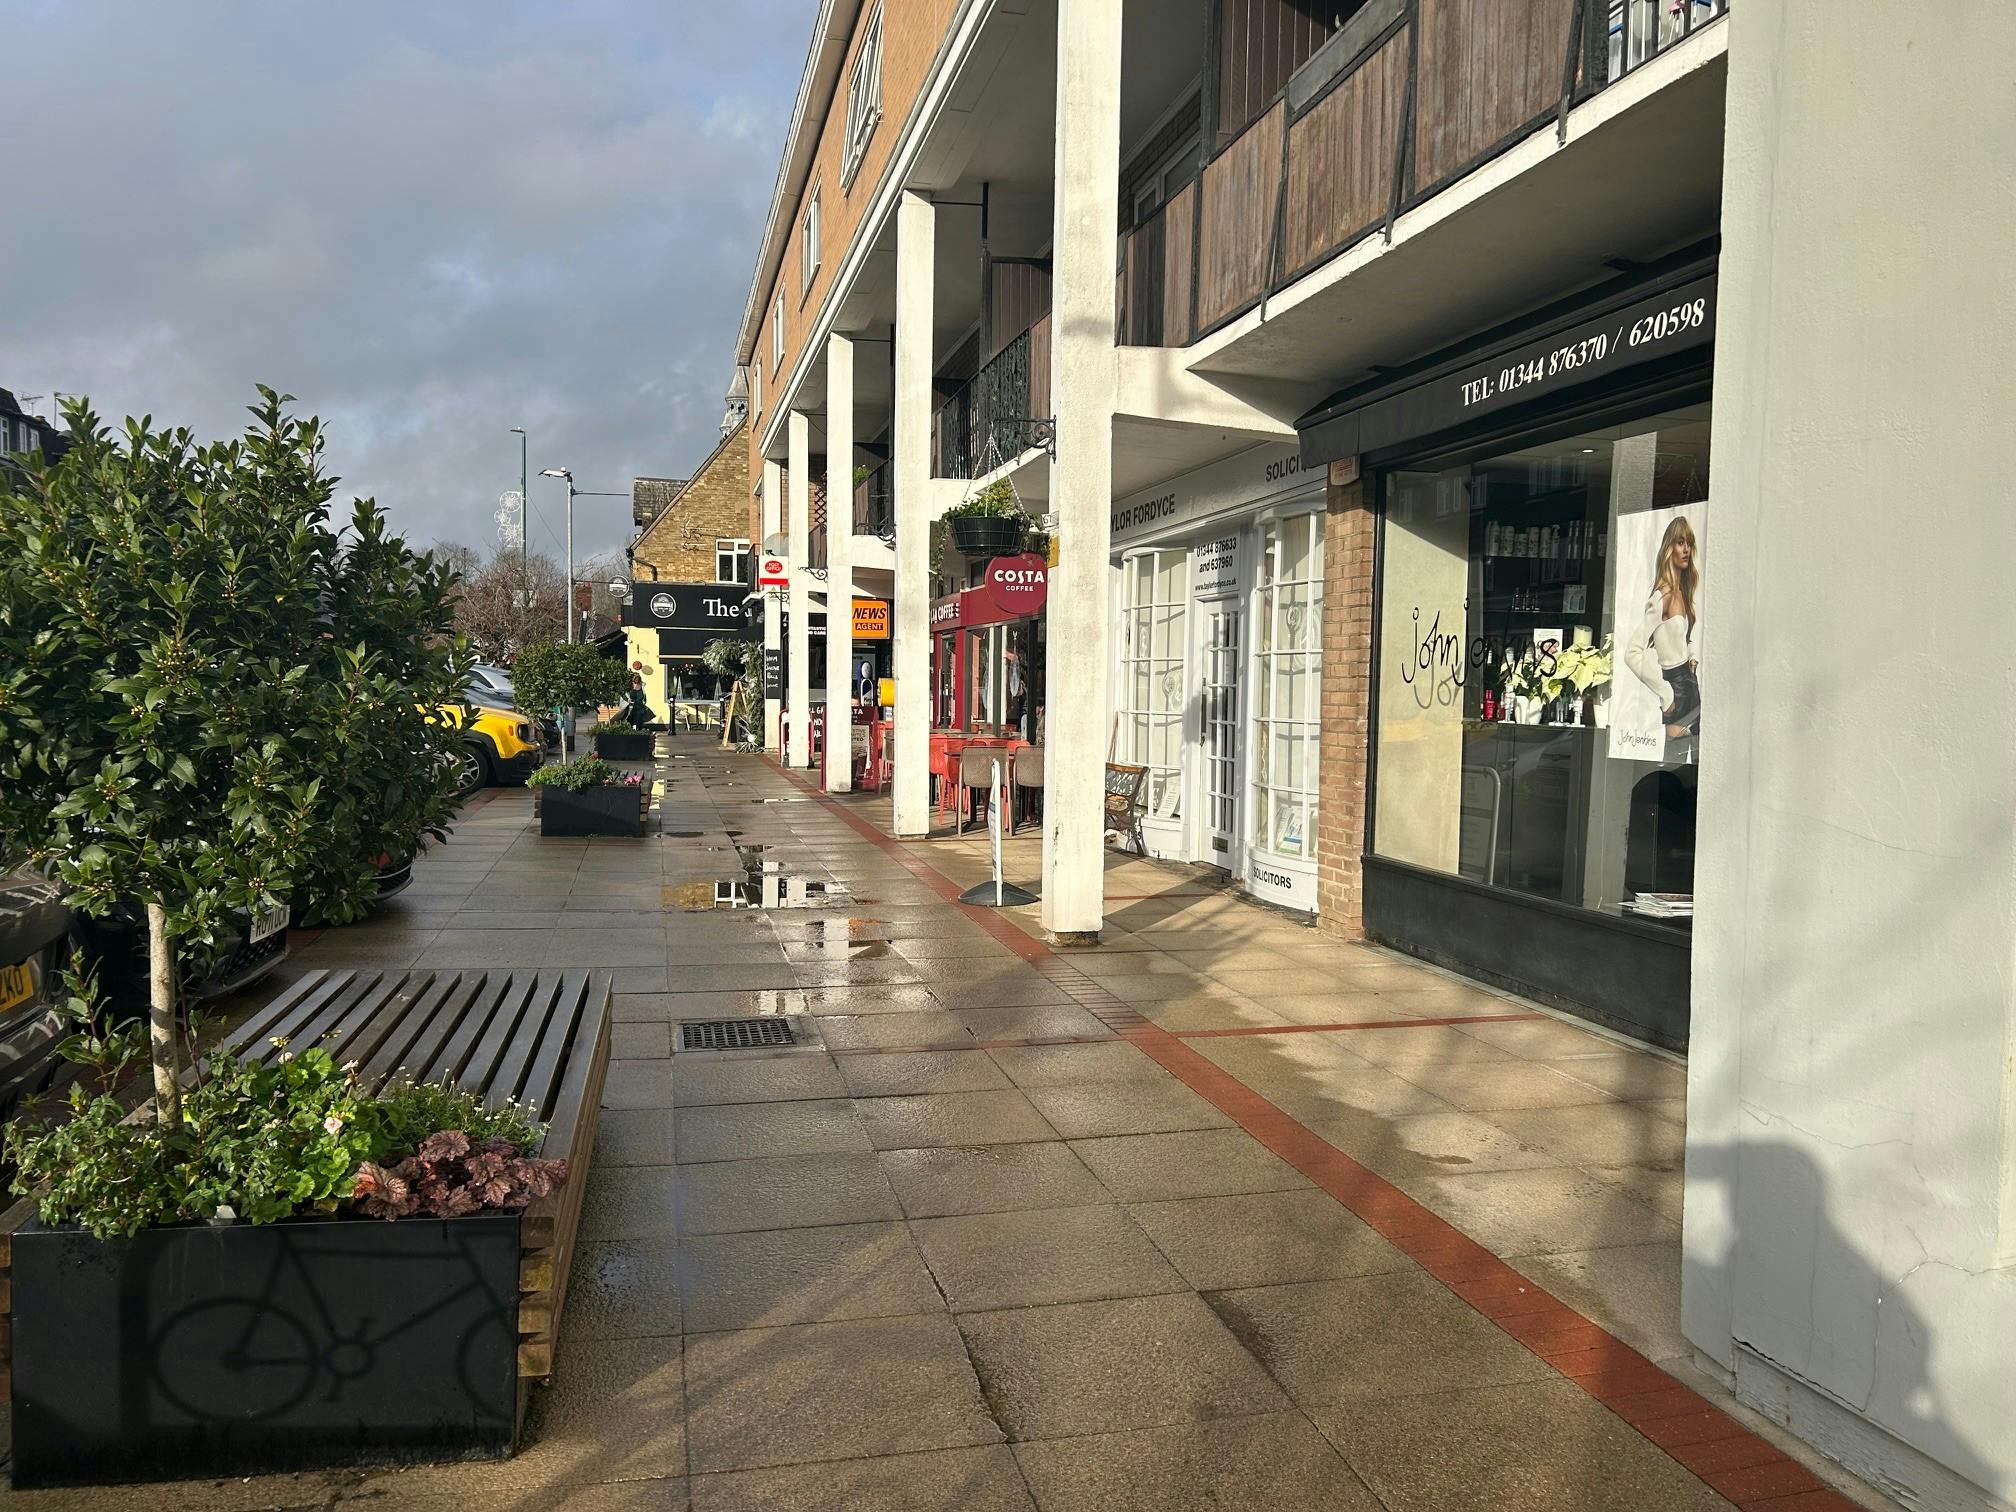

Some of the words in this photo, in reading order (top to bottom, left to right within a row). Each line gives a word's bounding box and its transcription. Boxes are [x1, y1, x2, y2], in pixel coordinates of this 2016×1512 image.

[1461, 376, 1495, 406] TEL:
[1499, 357, 1544, 392] 01344
[1549, 333, 1608, 376] 876370
[1628, 297, 1706, 347] 620598
[1266, 454, 1306, 482] SOLICI
[1110, 509, 1131, 533] YLOR
[1133, 493, 1176, 527] FORDYCE
[1197, 543, 1214, 557] 01344
[1199, 559, 1211, 573] and
[994, 569, 1045, 584] COSTA
[703, 598, 740, 617] The
[853, 607, 887, 620] NEWS
[1253, 865, 1292, 889] SOLICITORS
